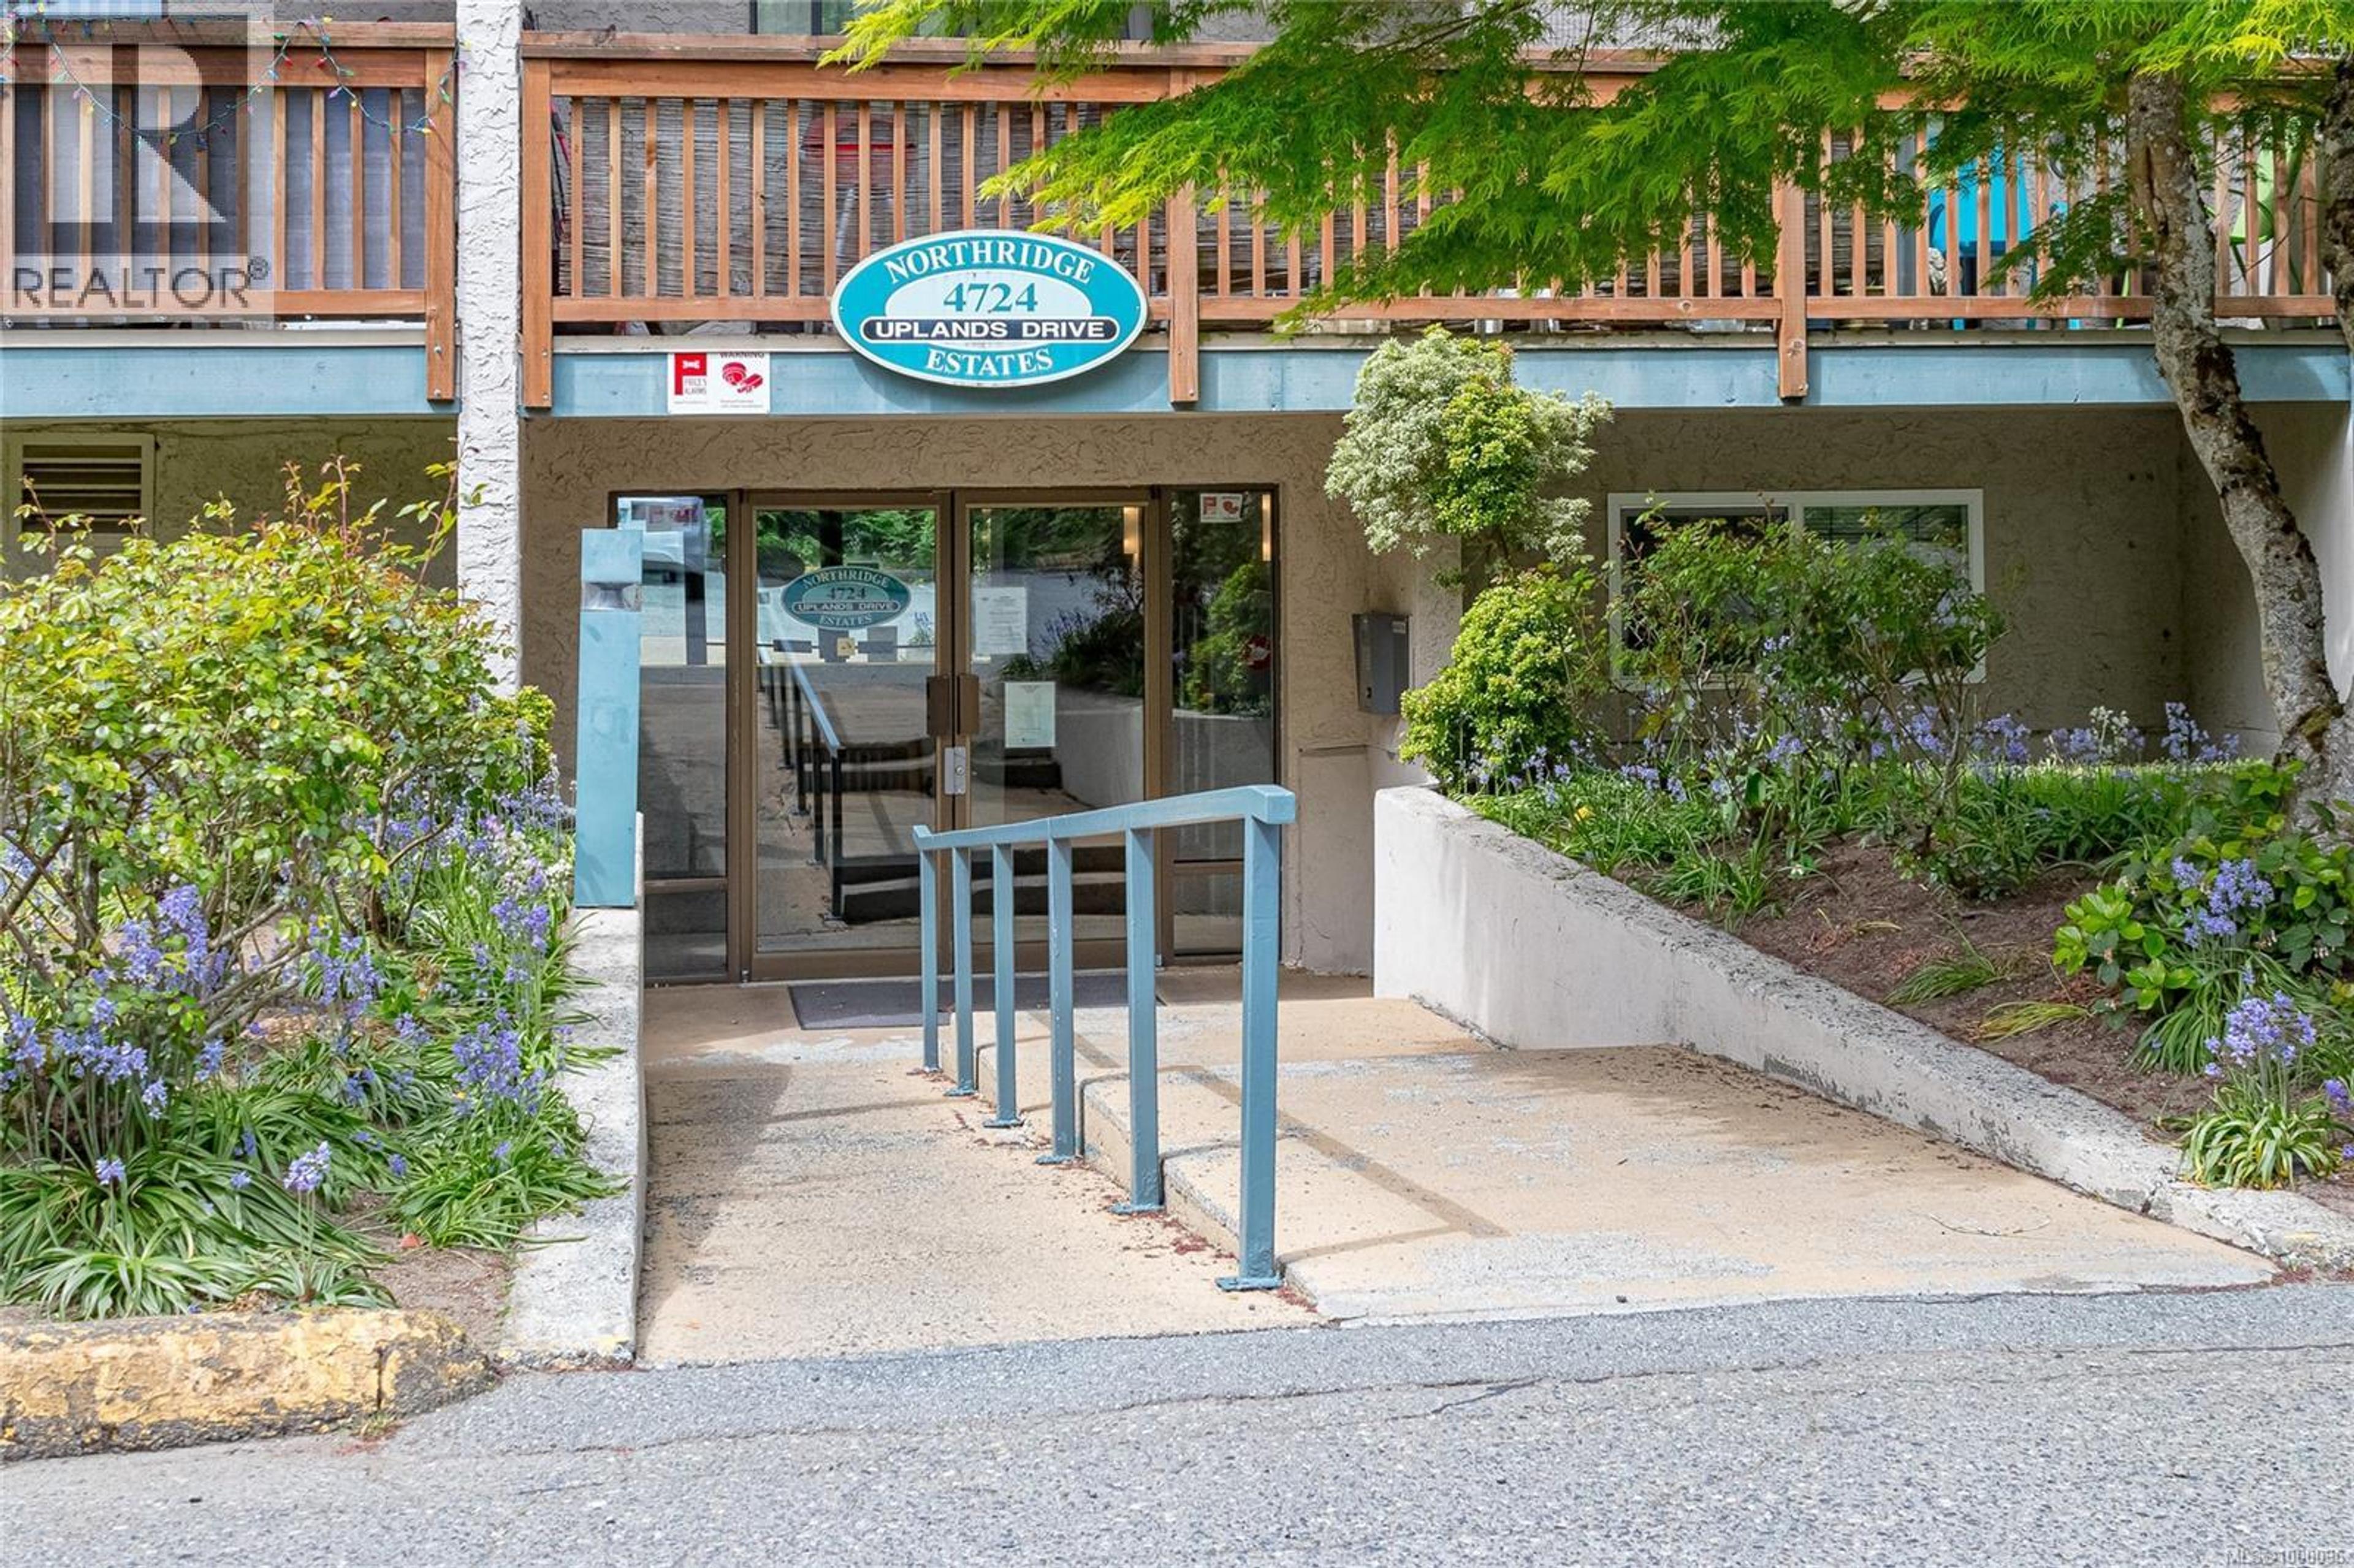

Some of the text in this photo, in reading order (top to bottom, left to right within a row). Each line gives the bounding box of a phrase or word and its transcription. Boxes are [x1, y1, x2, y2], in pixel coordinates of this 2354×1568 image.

[885, 240, 1095, 285] NORTHRIDGE
[943, 282, 1038, 313] 4724
[875, 321, 1105, 338] UPLANDS DRIVE
[926, 348, 1054, 376] ESTATES
[802, 569, 890, 589] NORTHRIDGE
[829, 587, 867, 600] 4724
[798, 603, 894, 611] UPLANDS DRIVE
[819, 614, 872, 626] ESTATES
